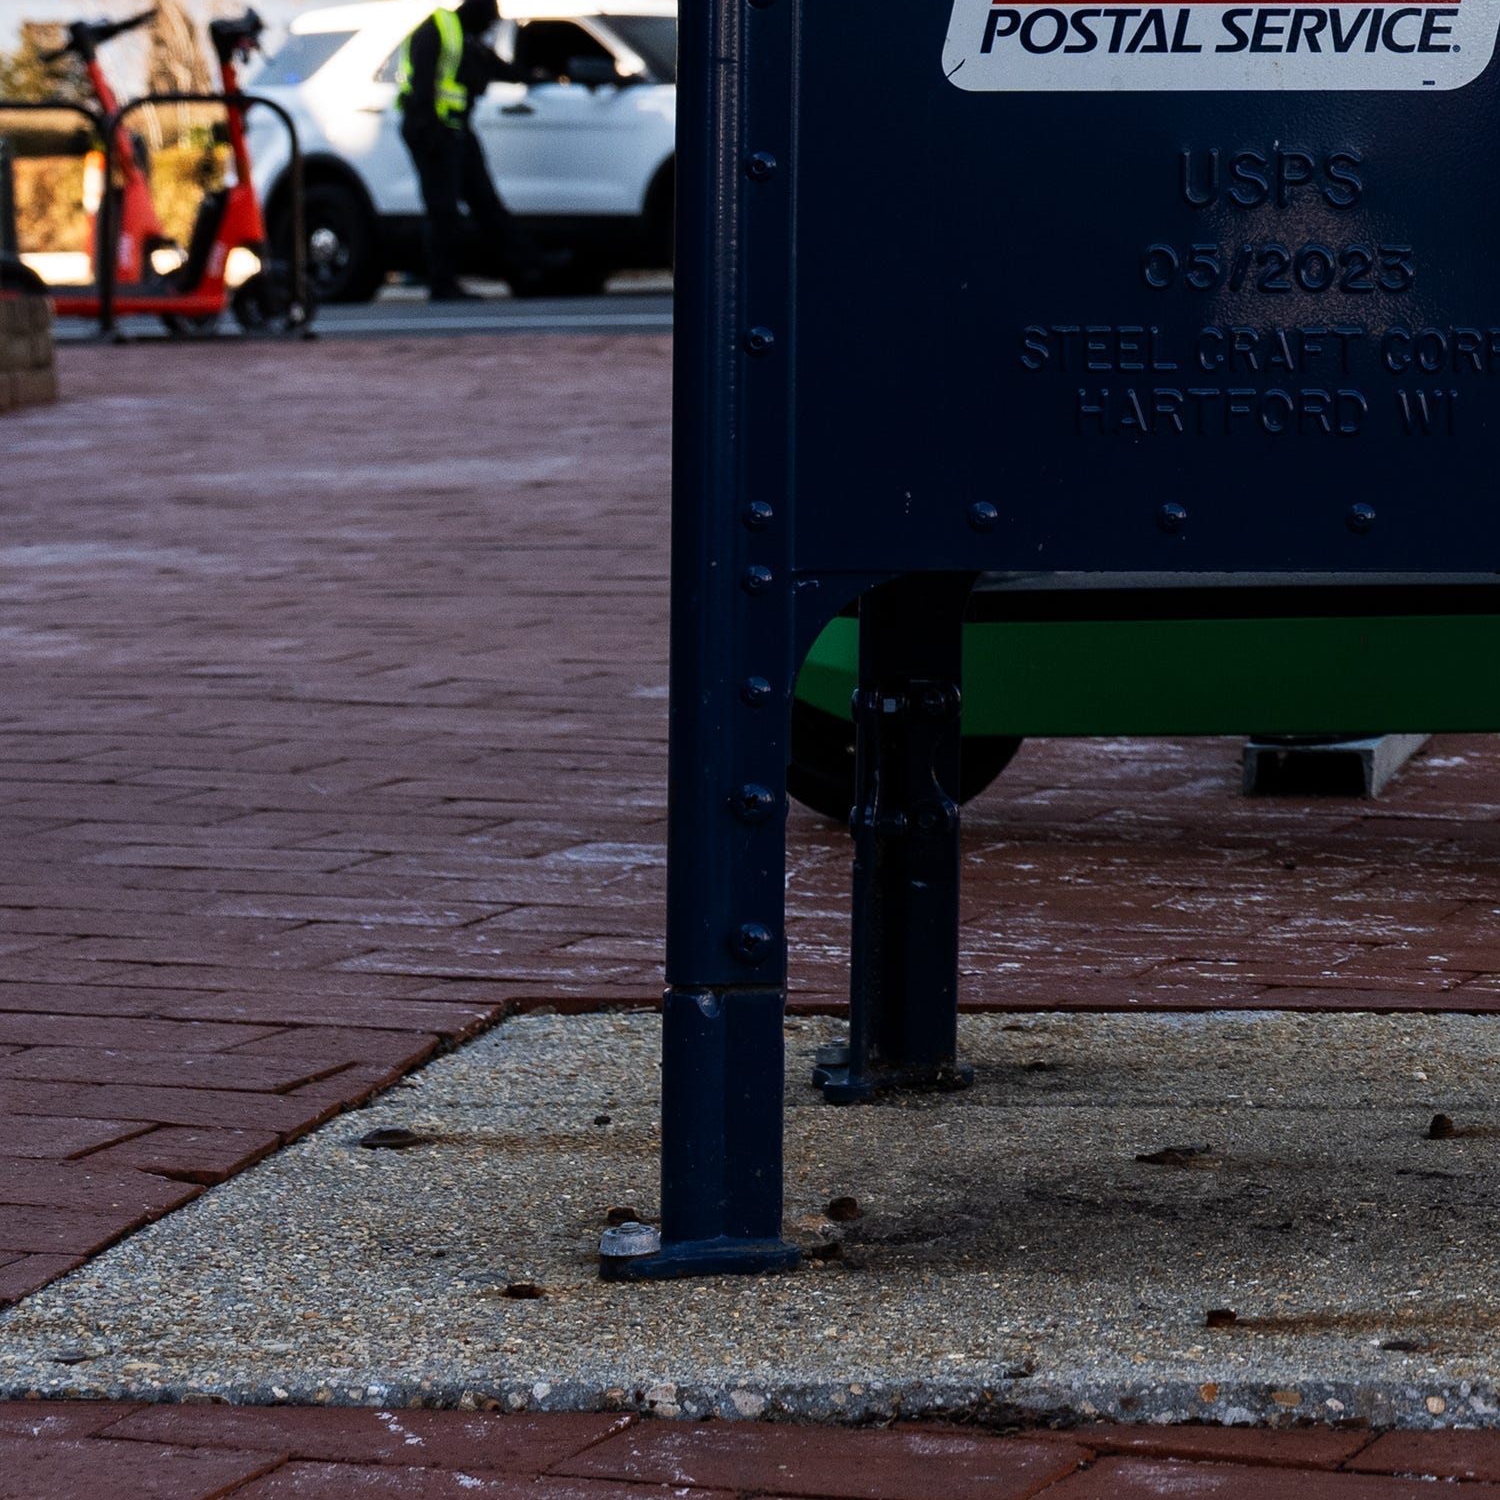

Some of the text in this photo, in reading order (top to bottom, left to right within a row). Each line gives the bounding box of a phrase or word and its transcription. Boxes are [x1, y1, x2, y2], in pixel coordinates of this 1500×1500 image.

[980, 8, 1459, 54] POSTAL SERVICE
[1179, 147, 1365, 208] USPS
[1019, 325, 1178, 373] STEEL
[1199, 325, 1364, 373] CRAFT
[1075, 387, 1461, 436] HARTFORD WI
